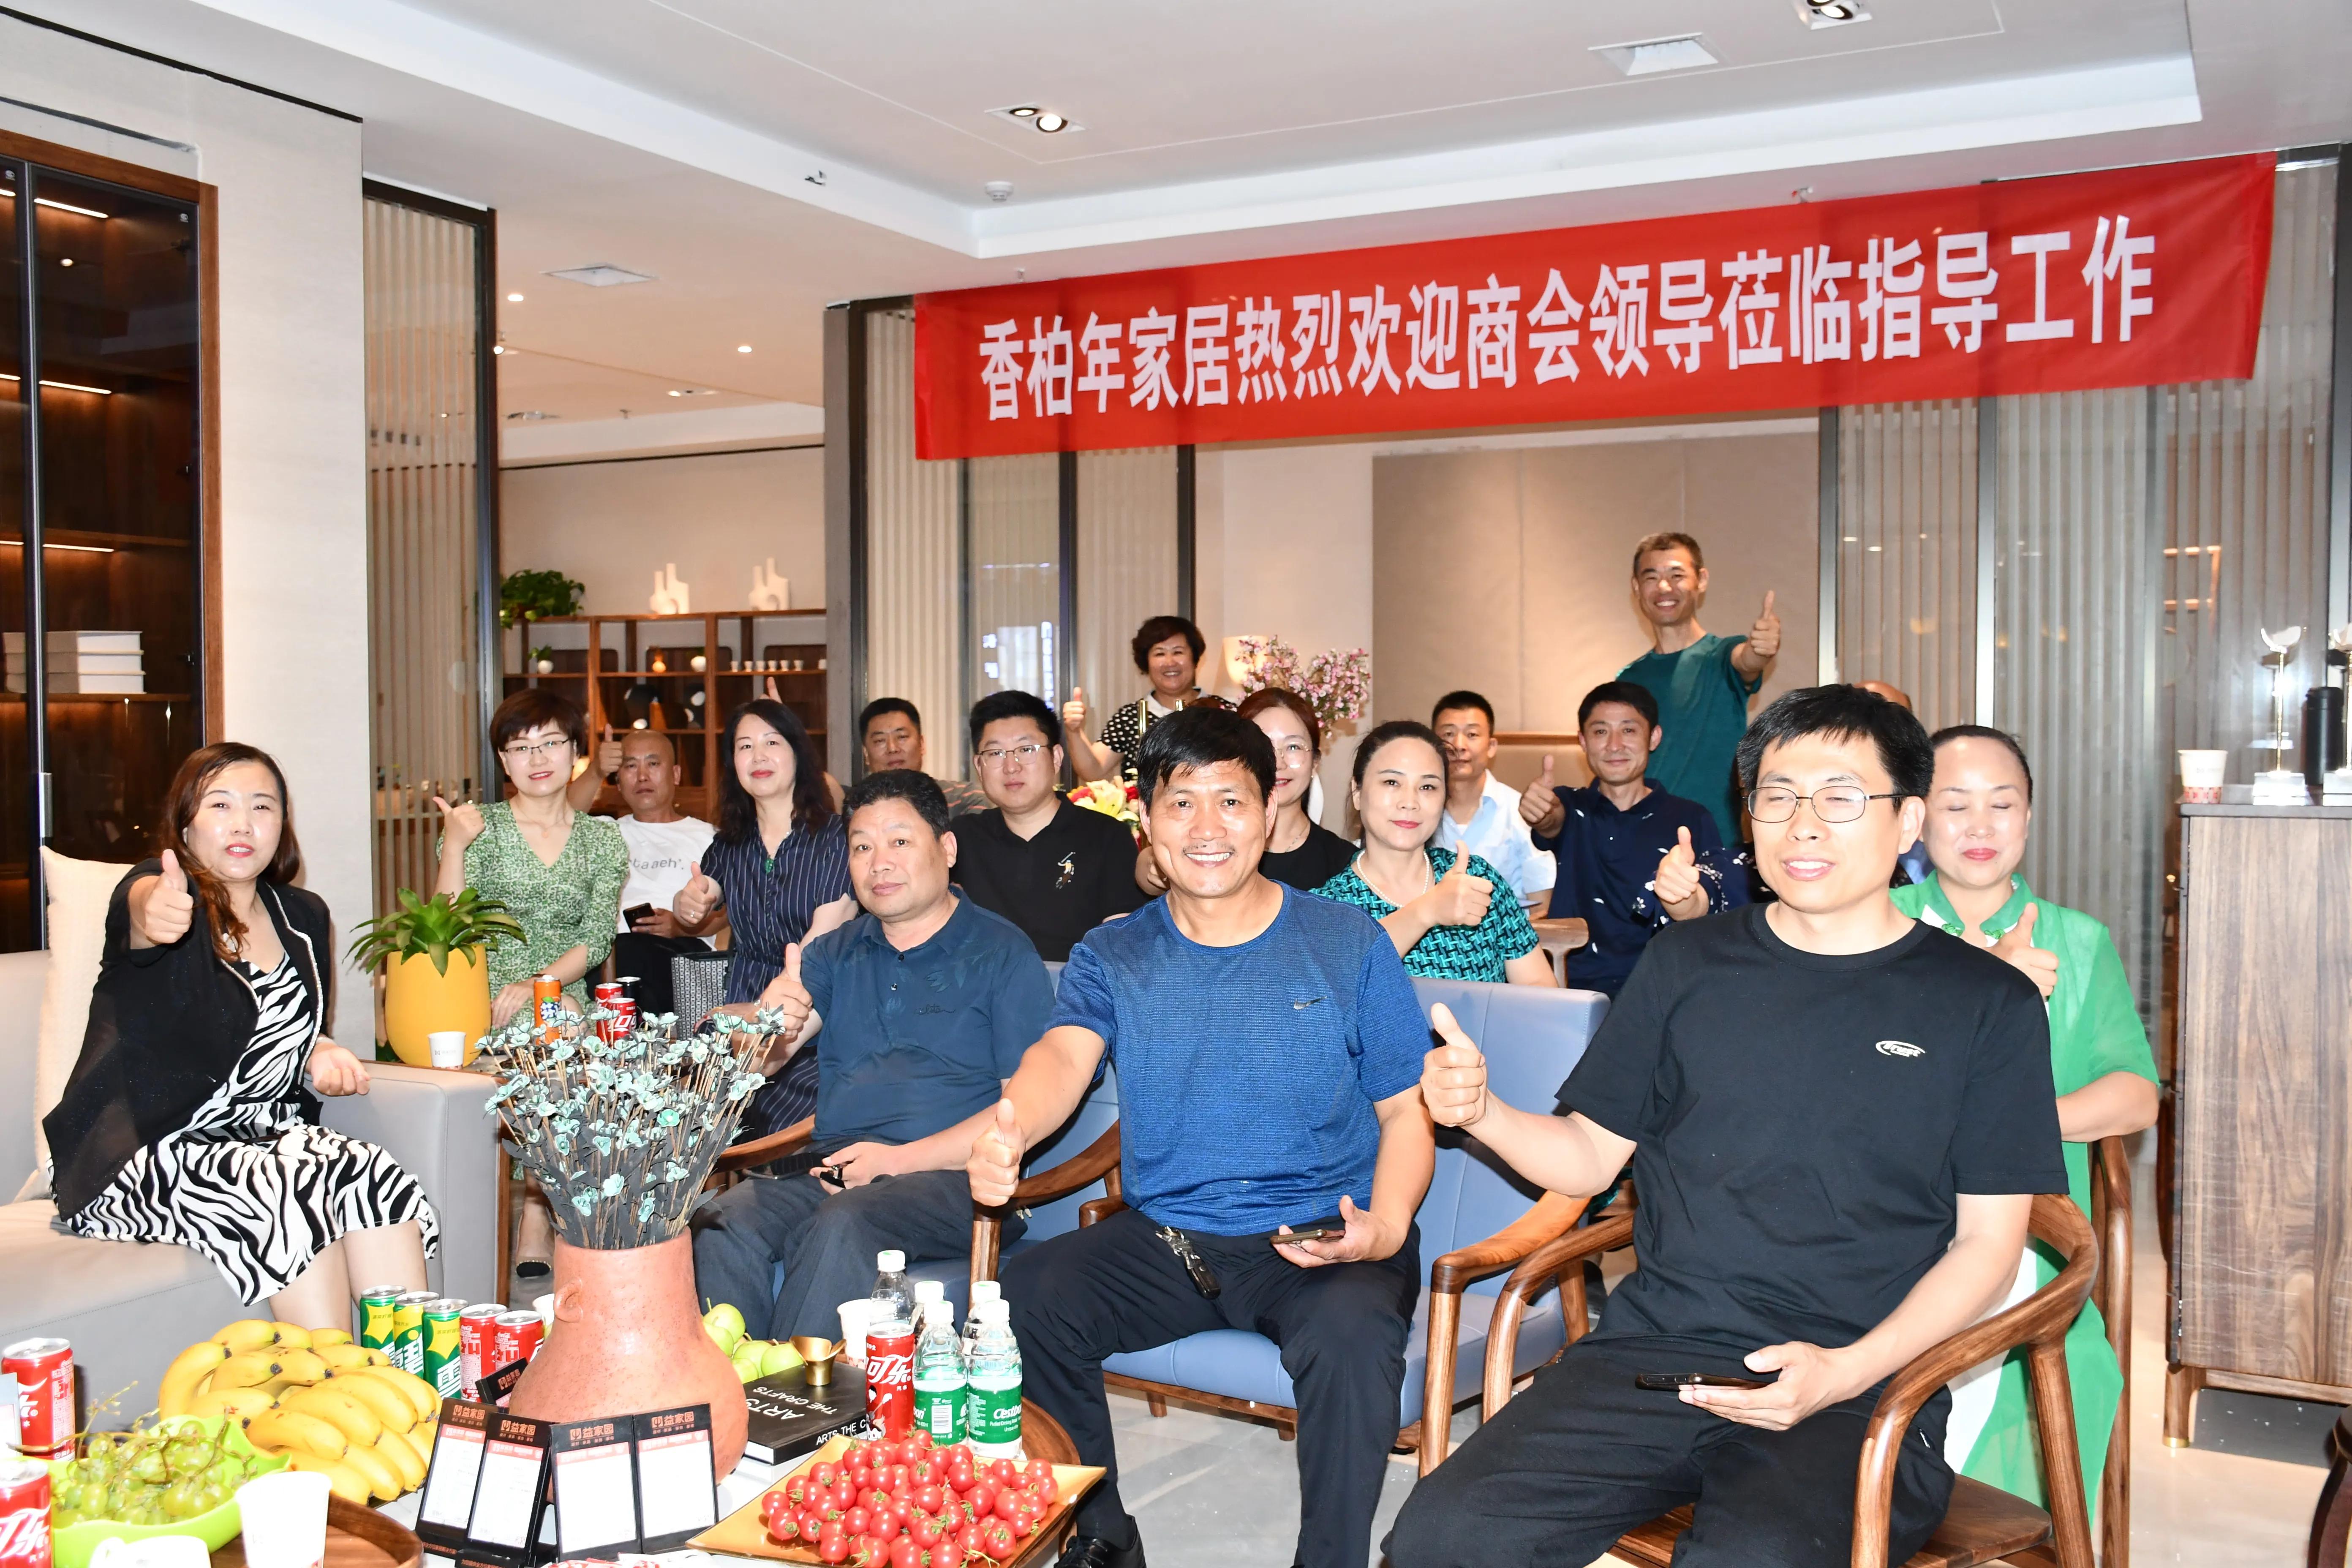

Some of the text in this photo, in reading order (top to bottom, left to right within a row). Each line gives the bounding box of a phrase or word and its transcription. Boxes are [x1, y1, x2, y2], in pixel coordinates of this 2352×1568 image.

[980, 214, 2155, 421] 香柏年家居热烈欢迎商会领导莅临指导工作
[753, 1386, 838, 1415] THE CRAFTS
[664, 1411, 694, 1426] 益家园
[510, 1421, 536, 1436] 益家园
[583, 1423, 614, 1438] 益家园
[841, 1422, 857, 1435] THE
